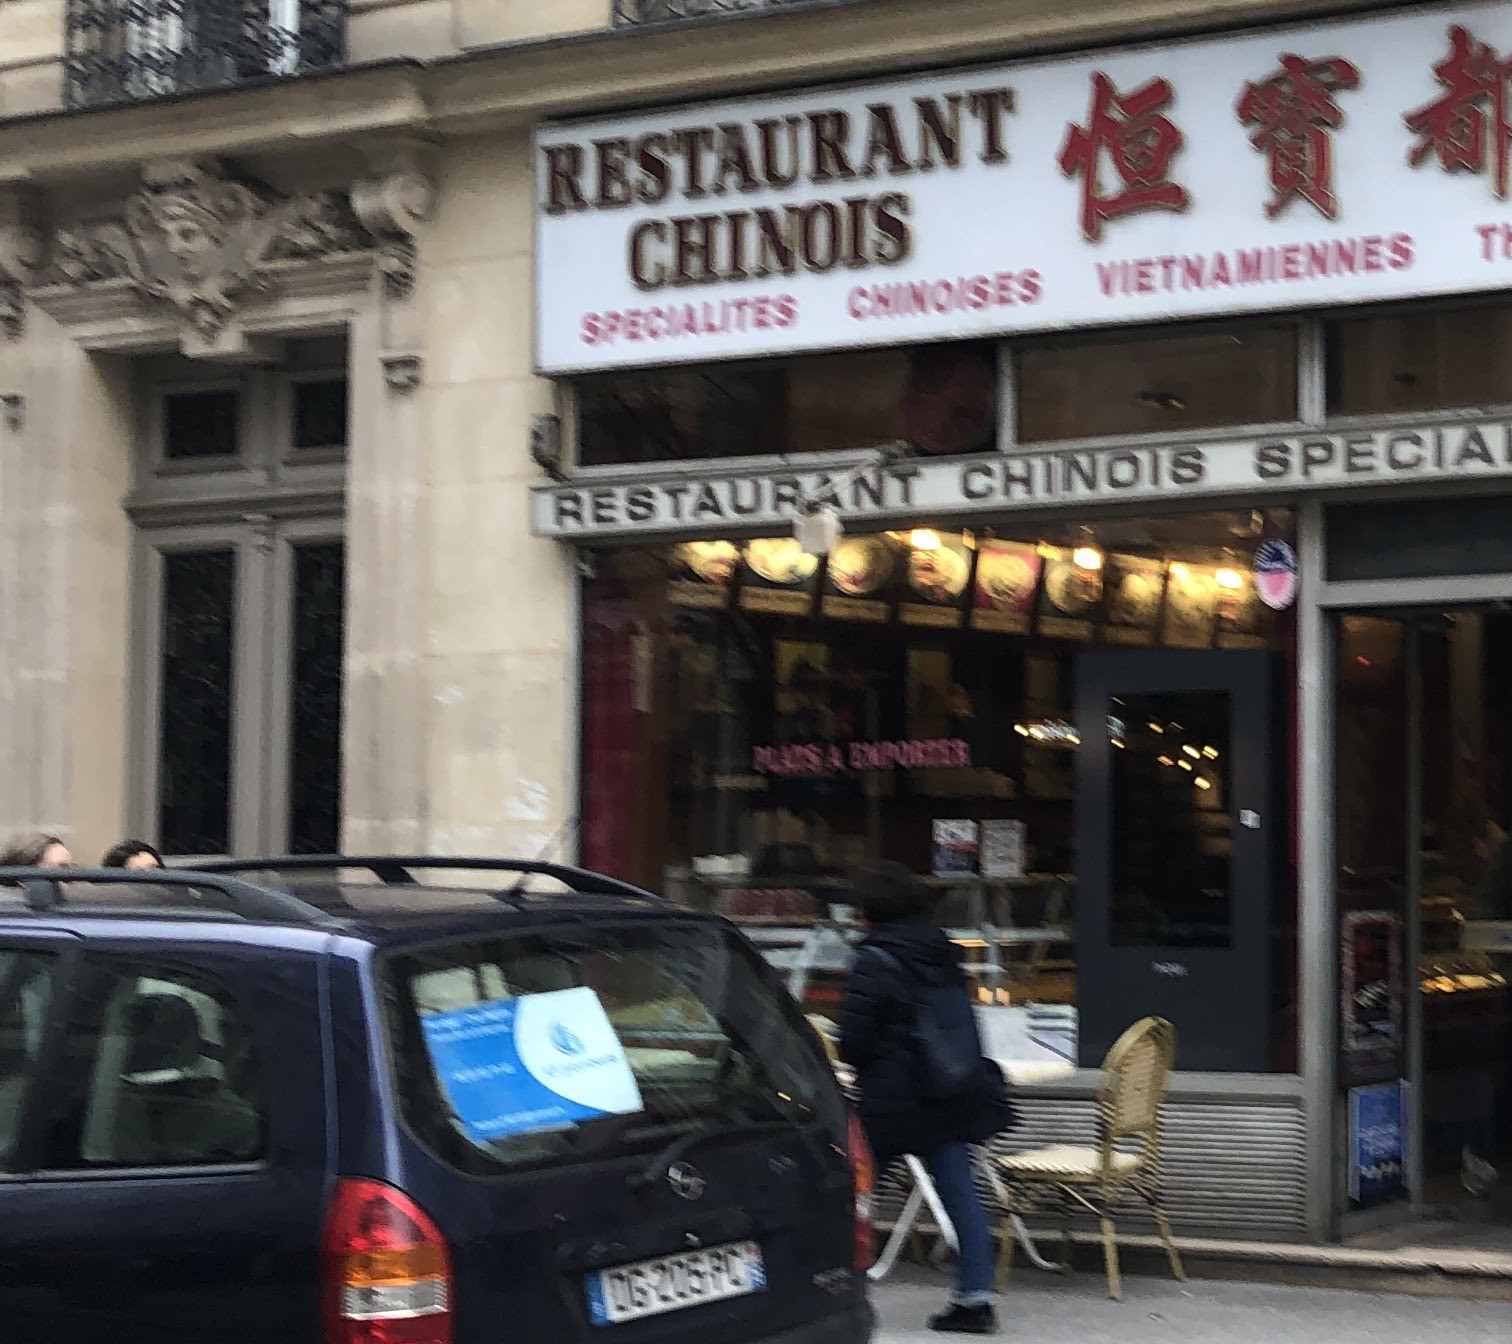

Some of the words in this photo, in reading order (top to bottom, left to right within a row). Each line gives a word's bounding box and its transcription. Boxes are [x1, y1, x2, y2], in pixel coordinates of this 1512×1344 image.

[541, 86, 1016, 216] RESTAURANT
[579, 294, 799, 346] SPECIALITES
[847, 268, 1044, 321] CHINOISES
[1096, 232, 1416, 298] VIETNAMIENNES
[628, 191, 916, 293] CHINOIS
[960, 446, 1208, 501] CHINOIS
